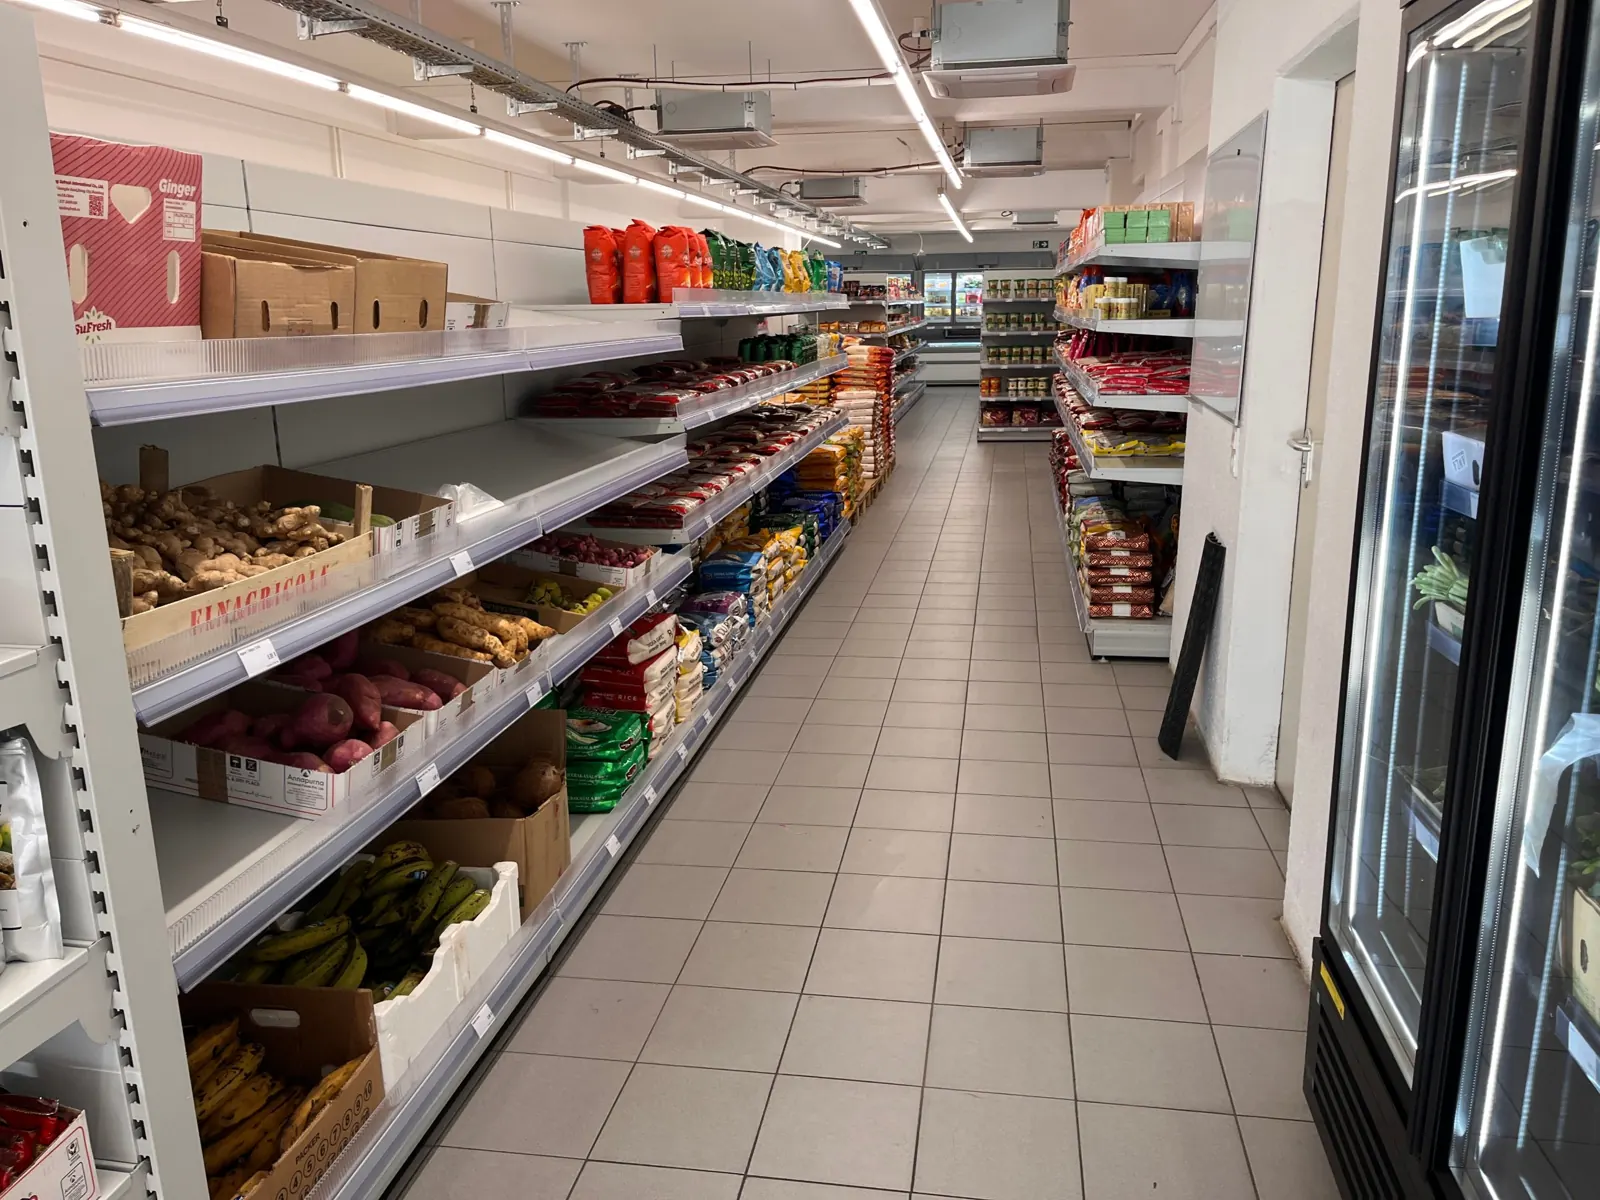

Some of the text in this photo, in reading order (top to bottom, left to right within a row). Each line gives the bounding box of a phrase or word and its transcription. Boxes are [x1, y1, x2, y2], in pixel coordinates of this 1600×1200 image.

[159, 178, 196, 198] Ginger
[75, 319, 112, 336] SuFresh
[617, 694, 638, 702] RICE
[287, 773, 325, 787] Annapurna
[364, 1085, 373, 1099] 10
[295, 1132, 321, 1165] PACKER
